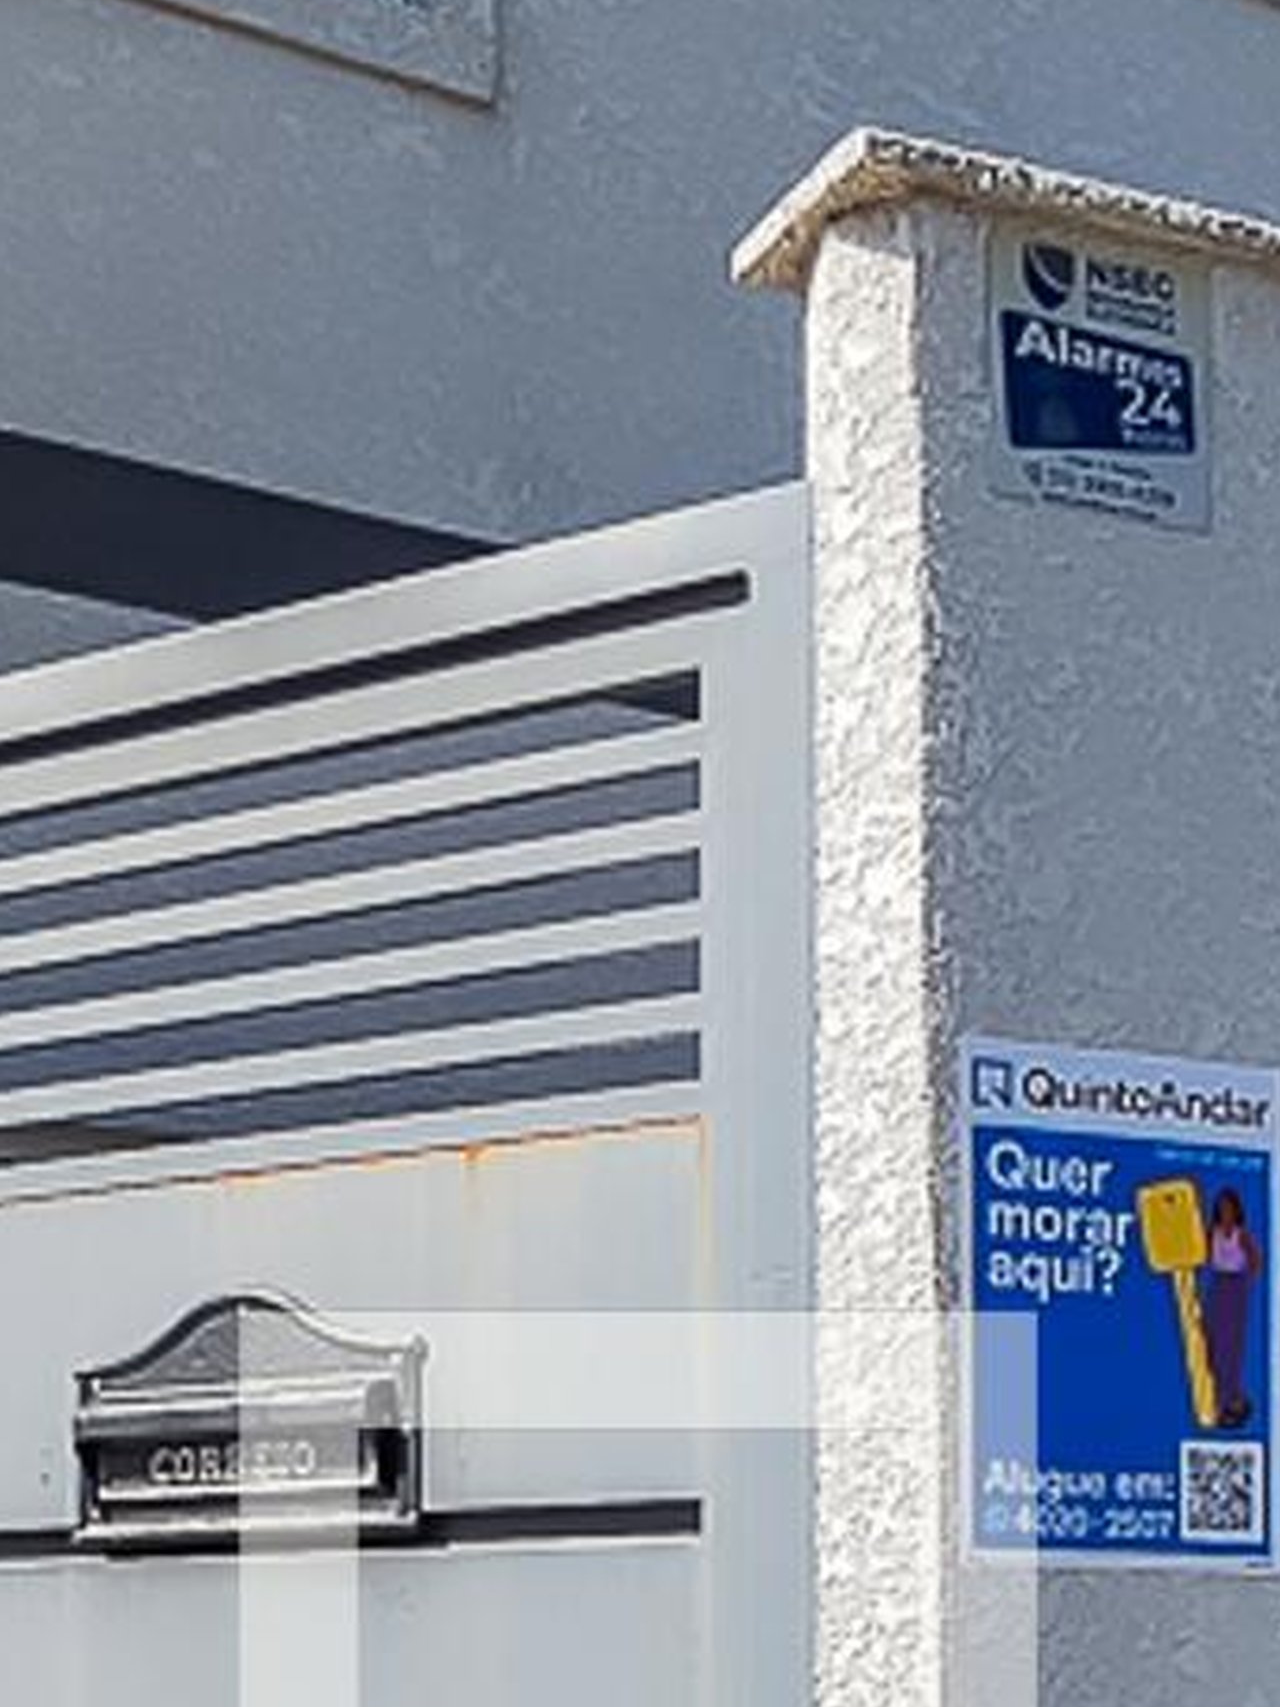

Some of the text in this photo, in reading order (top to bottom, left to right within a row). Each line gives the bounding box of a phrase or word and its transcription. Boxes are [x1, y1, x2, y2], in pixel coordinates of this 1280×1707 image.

[1014, 321, 1183, 388] Alarmes
[1116, 377, 1183, 428] 24
[1023, 1066, 1269, 1128] QuintoAndar
[987, 1139, 1114, 1197] Quer
[987, 1198, 1134, 1249] morar
[987, 1244, 1122, 1305] aqui?
[983, 1459, 1107, 1505] Alugue
